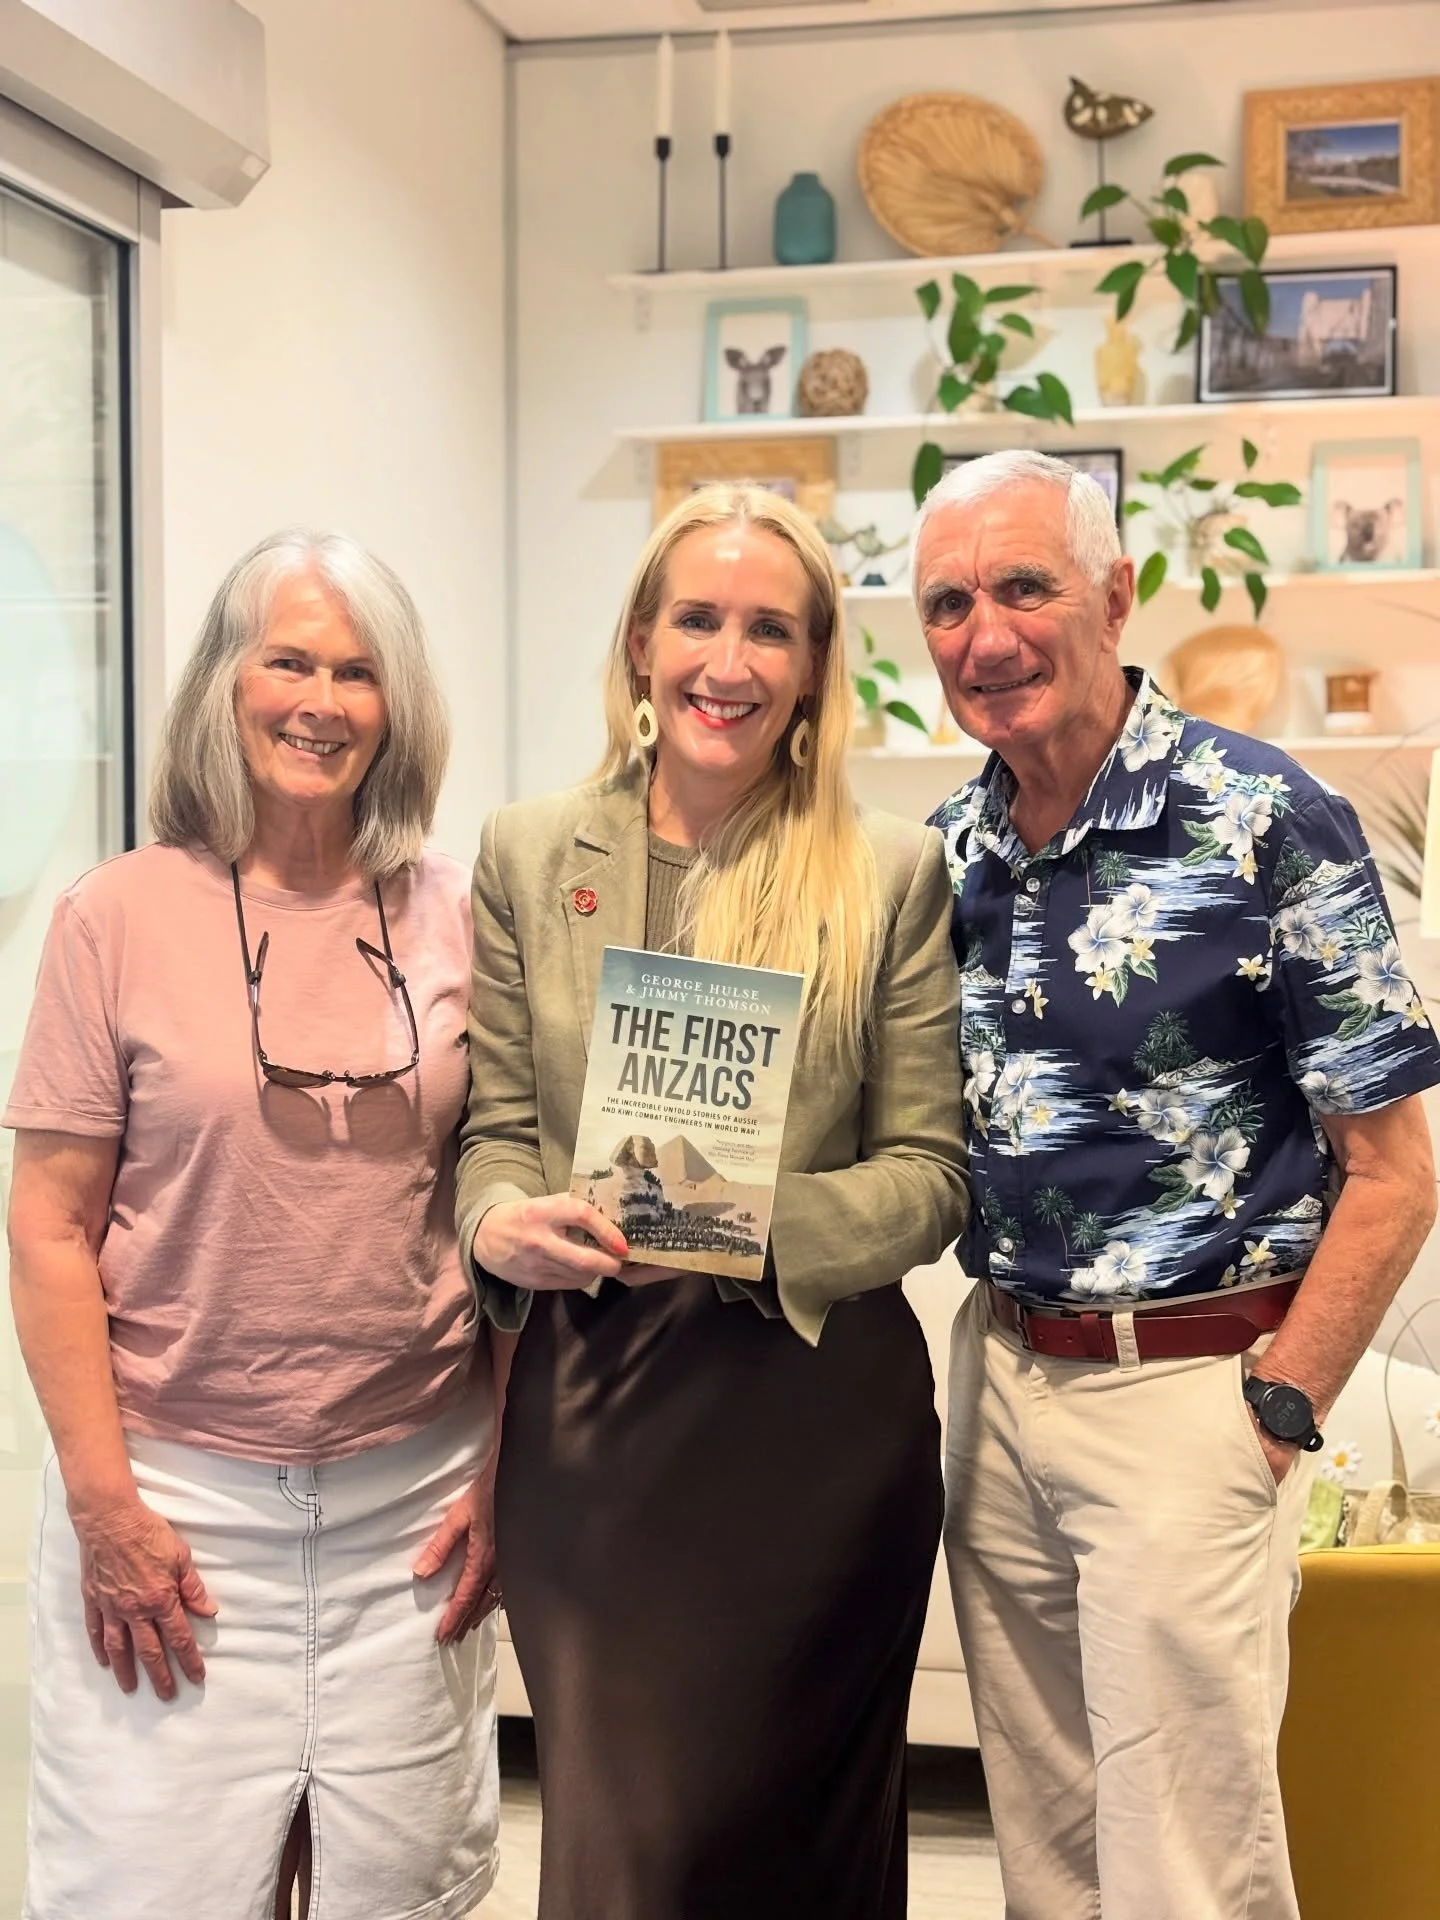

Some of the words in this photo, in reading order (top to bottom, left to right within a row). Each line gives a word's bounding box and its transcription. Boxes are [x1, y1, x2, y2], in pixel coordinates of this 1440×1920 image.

[625, 984, 636, 995] &
[639, 986, 689, 1003] JIMMY
[695, 994, 772, 1016] THOMSON
[641, 973, 703, 992] GEORGE
[709, 983, 760, 1000] HULSE
[611, 1003, 675, 1052] THE
[682, 1014, 781, 1068] FIRST
[617, 1052, 755, 1111] ANZACS
[601, 1106, 616, 1114] AND
[618, 1108, 633, 1117] KIWI
[634, 1110, 662, 1121] COMBAT
[664, 1115, 703, 1128] ENGINEERS
[704, 1121, 713, 1129] IN
[714, 1123, 739, 1133] WORLD
[740, 1127, 756, 1136] WAR
[607, 1096, 619, 1105] THE
[621, 1099, 662, 1112] INCREDIBLE
[663, 1105, 691, 1116] UNTOLD
[692, 1109, 721, 1121] STORIES
[722, 1114, 732, 1122] OF
[733, 1116, 758, 1126] AUSSIE
